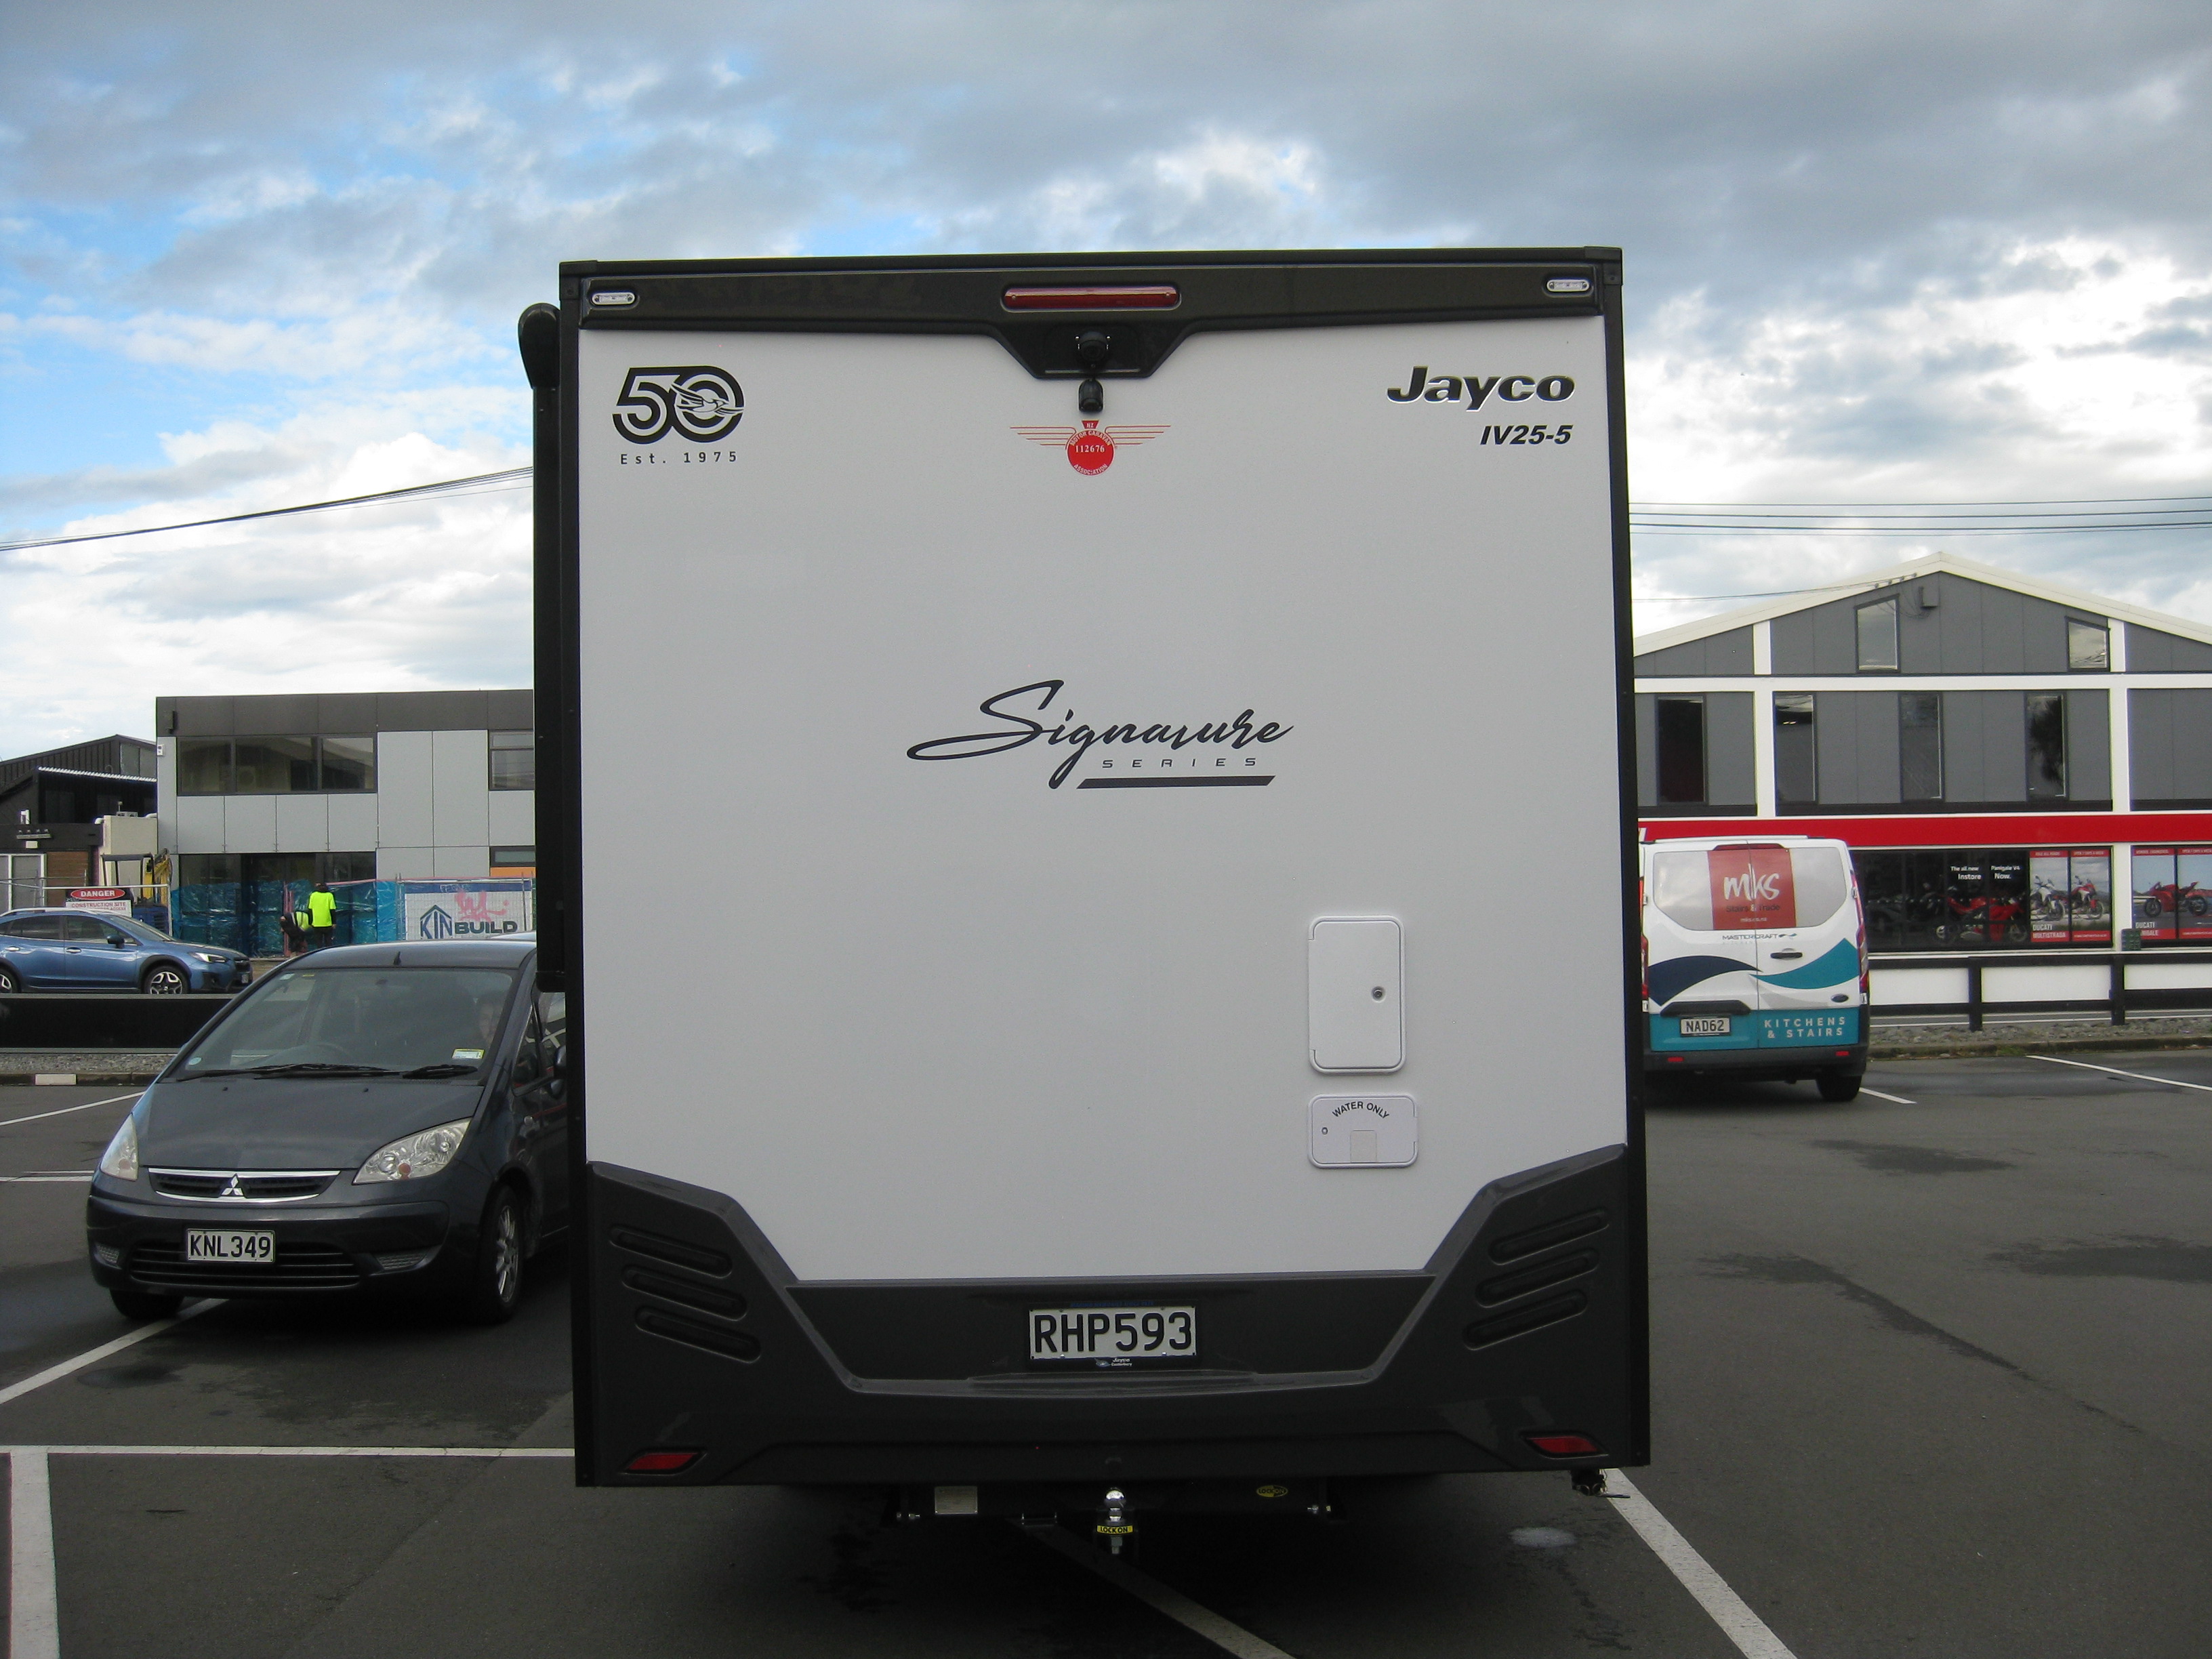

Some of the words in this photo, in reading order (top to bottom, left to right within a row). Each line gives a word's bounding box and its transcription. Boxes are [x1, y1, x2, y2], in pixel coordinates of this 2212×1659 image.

[1387, 366, 1575, 411] Jayco
[612, 365, 745, 445] 50
[1069, 431, 1087, 446] MOTOR
[1088, 430, 1112, 446] CARAVAN
[1480, 425, 1574, 445] IV25-5
[1076, 445, 1105, 453] 112676
[620, 453, 666, 464] Est.
[683, 451, 737, 464] 1975
[1073, 464, 1108, 475] ASSOCIATION
[1101, 757, 1257, 769] SERIES
[1723, 863, 1780, 901] mks
[1685, 1019, 1724, 1032] NAD62
[1764, 1017, 1846, 1028] KITCHENS
[1767, 1029, 1776, 1038] &
[1786, 1027, 1843, 1038] STAIRS
[1332, 1101, 1364, 1117] WATER
[1366, 1103, 1389, 1118] ONLY
[190, 1235, 271, 1258] KNL349
[1034, 1312, 1191, 1353] RHP593
